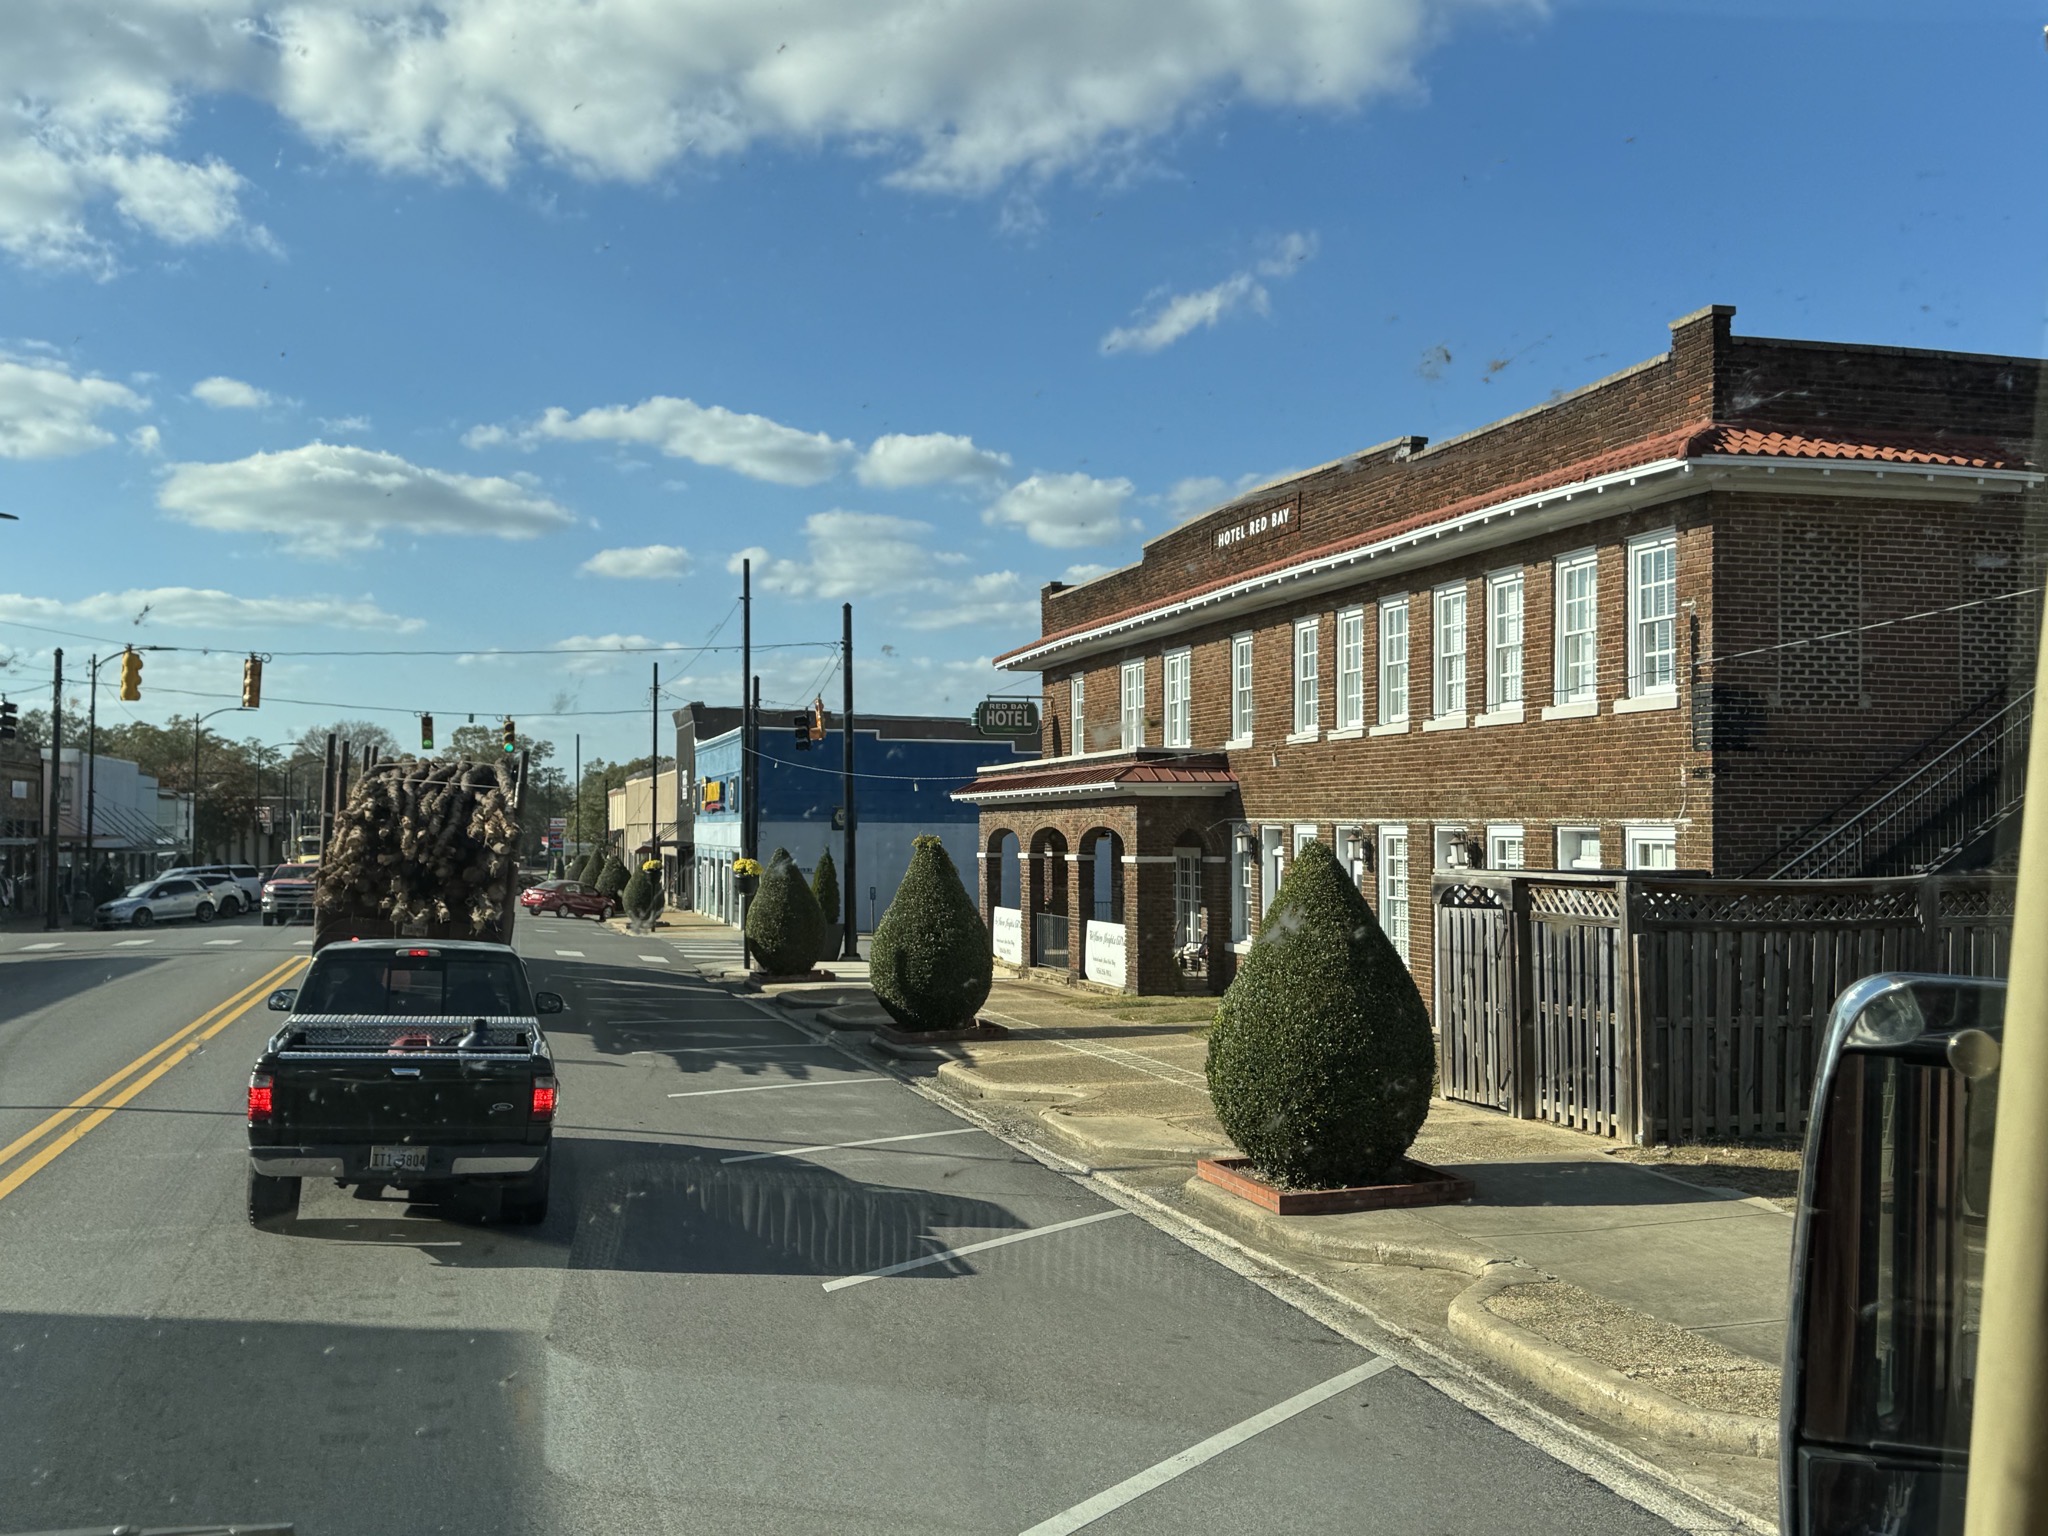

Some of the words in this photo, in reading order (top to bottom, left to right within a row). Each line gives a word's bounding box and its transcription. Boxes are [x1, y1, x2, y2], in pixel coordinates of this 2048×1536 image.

[1218, 525, 1245, 548] HOTEL
[1249, 516, 1267, 536] RED
[1271, 507, 1289, 527] BAY
[986, 710, 1032, 726] HOTEL
